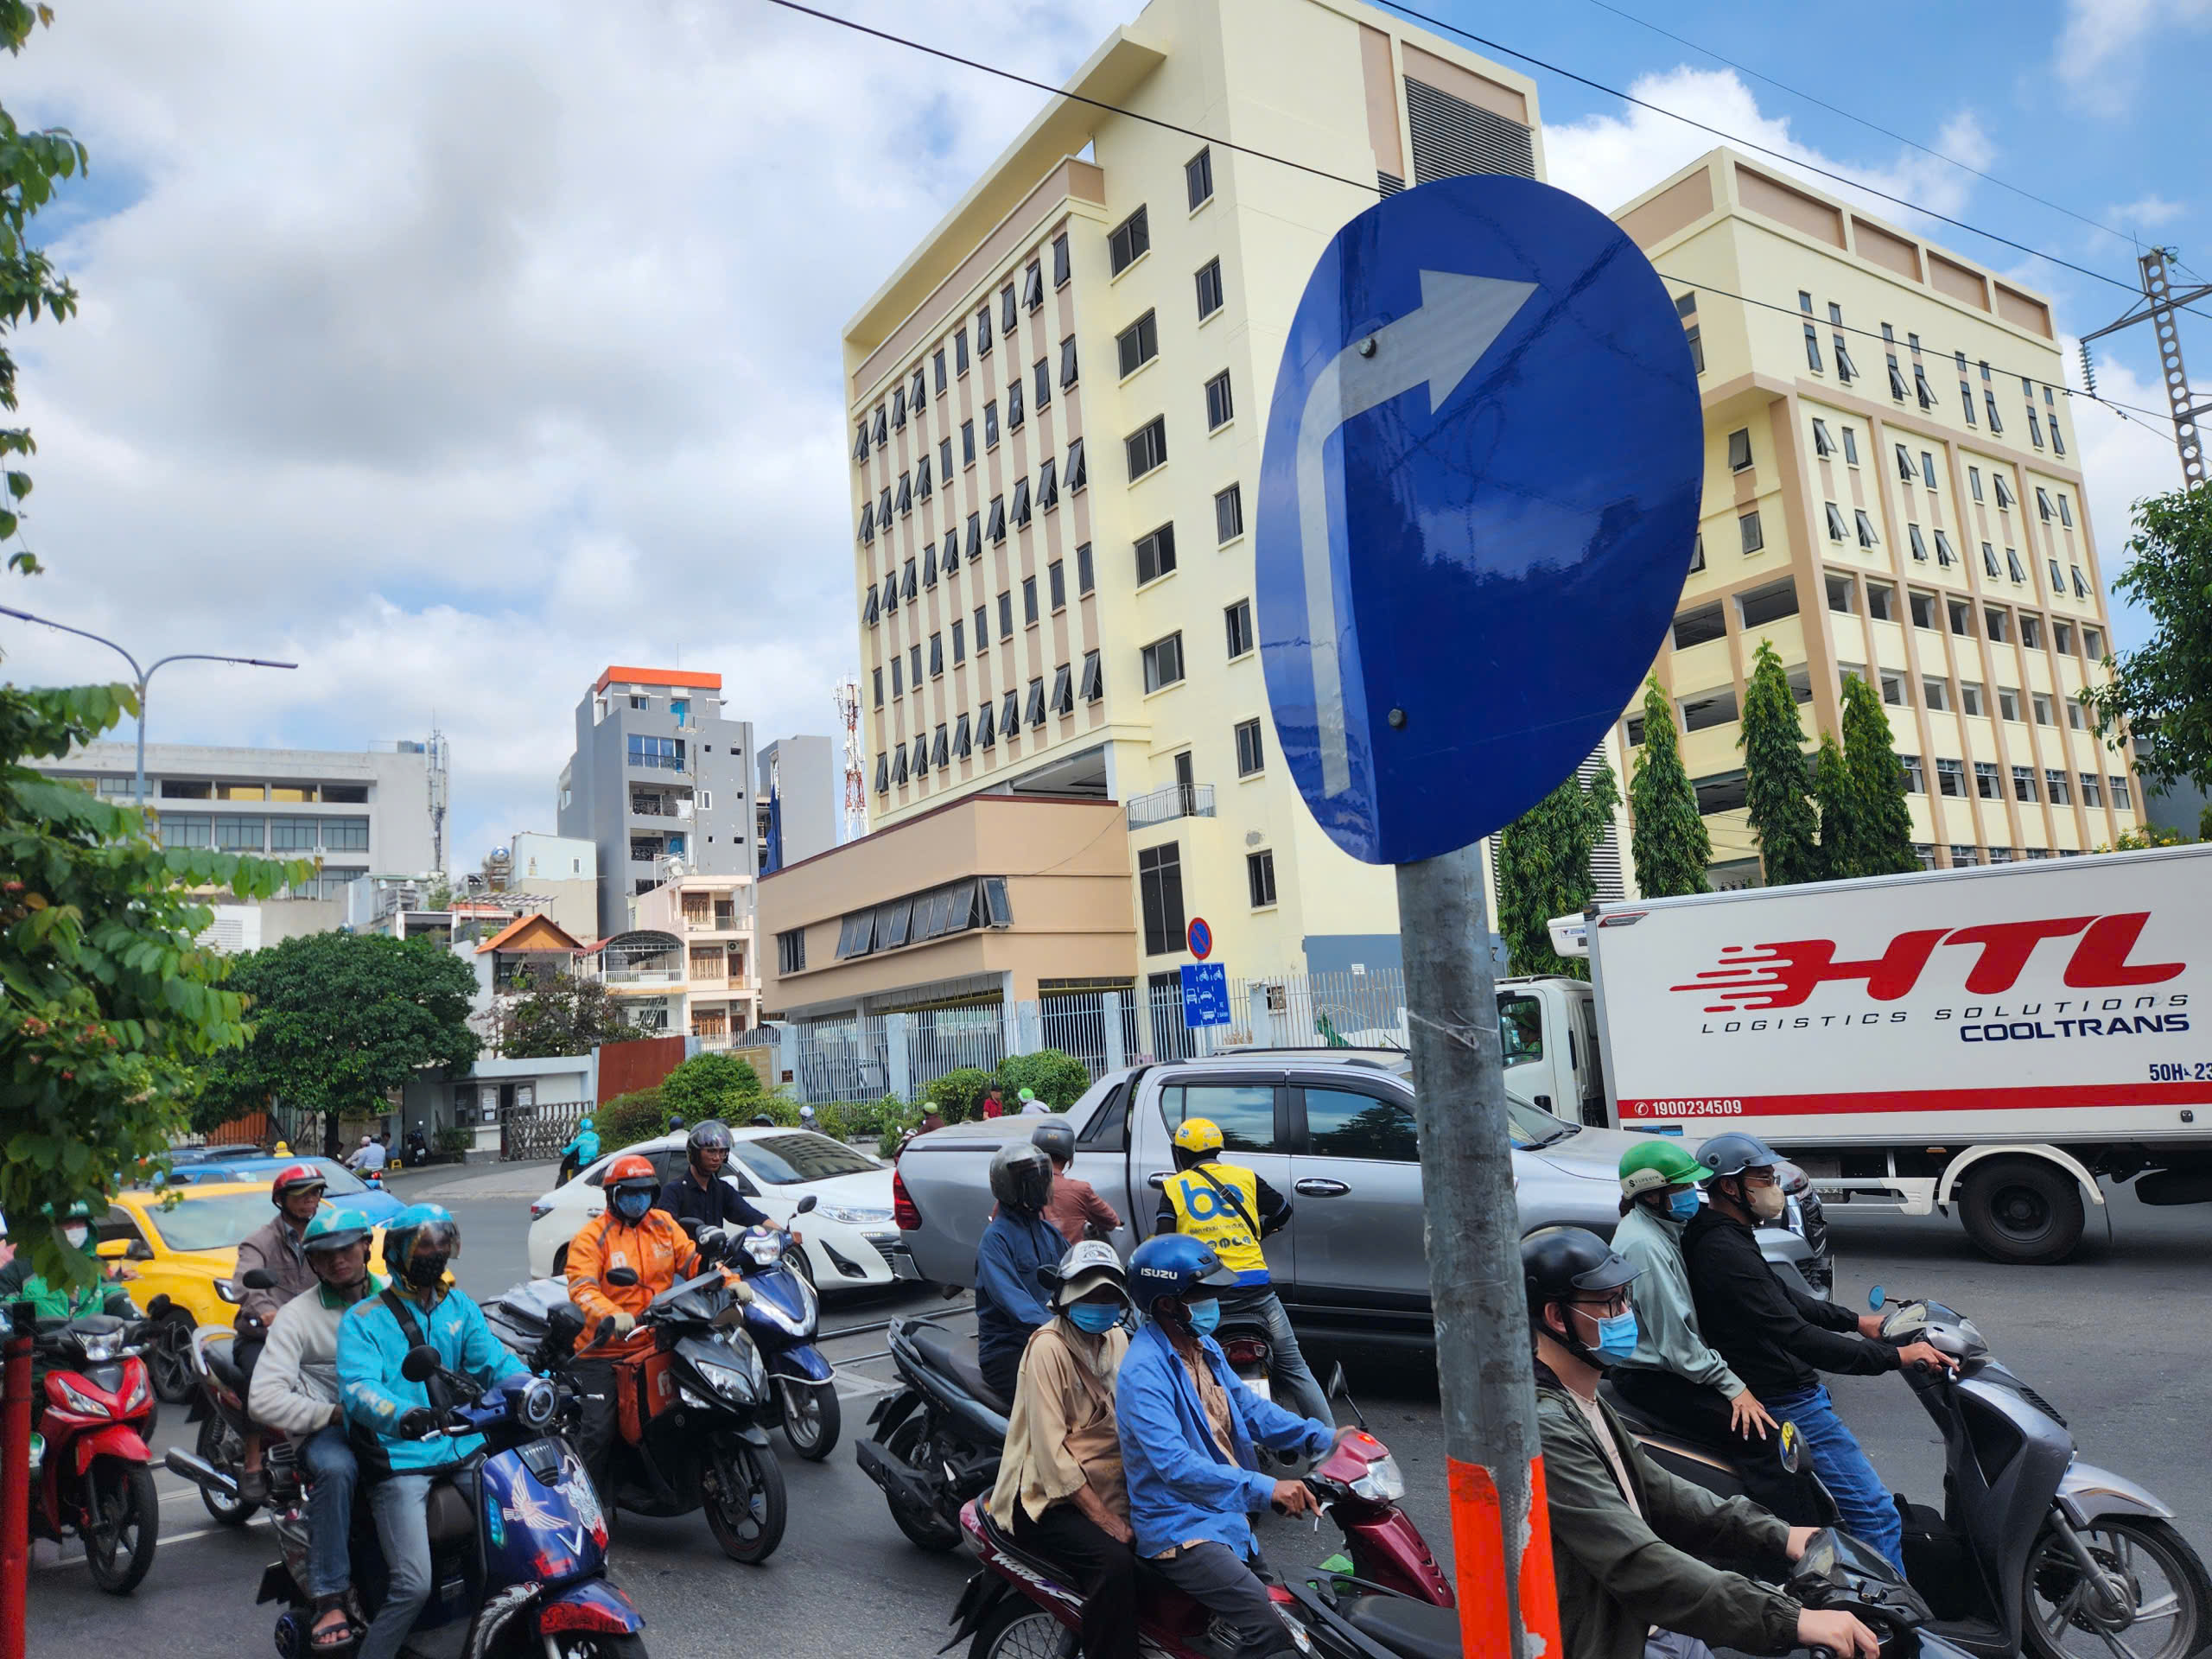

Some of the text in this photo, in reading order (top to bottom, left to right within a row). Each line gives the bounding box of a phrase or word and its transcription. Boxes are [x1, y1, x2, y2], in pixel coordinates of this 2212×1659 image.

[1702, 911, 2186, 1013] HTL
[1701, 995, 2189, 1033] LOGISTICS SOLUTIONS
[1960, 1014, 2190, 1042] COOLTRANS
[1652, 1099, 1742, 1116] 1900234509
[1179, 1179, 1244, 1221] be
[1141, 1268, 1178, 1280] ISUZU
